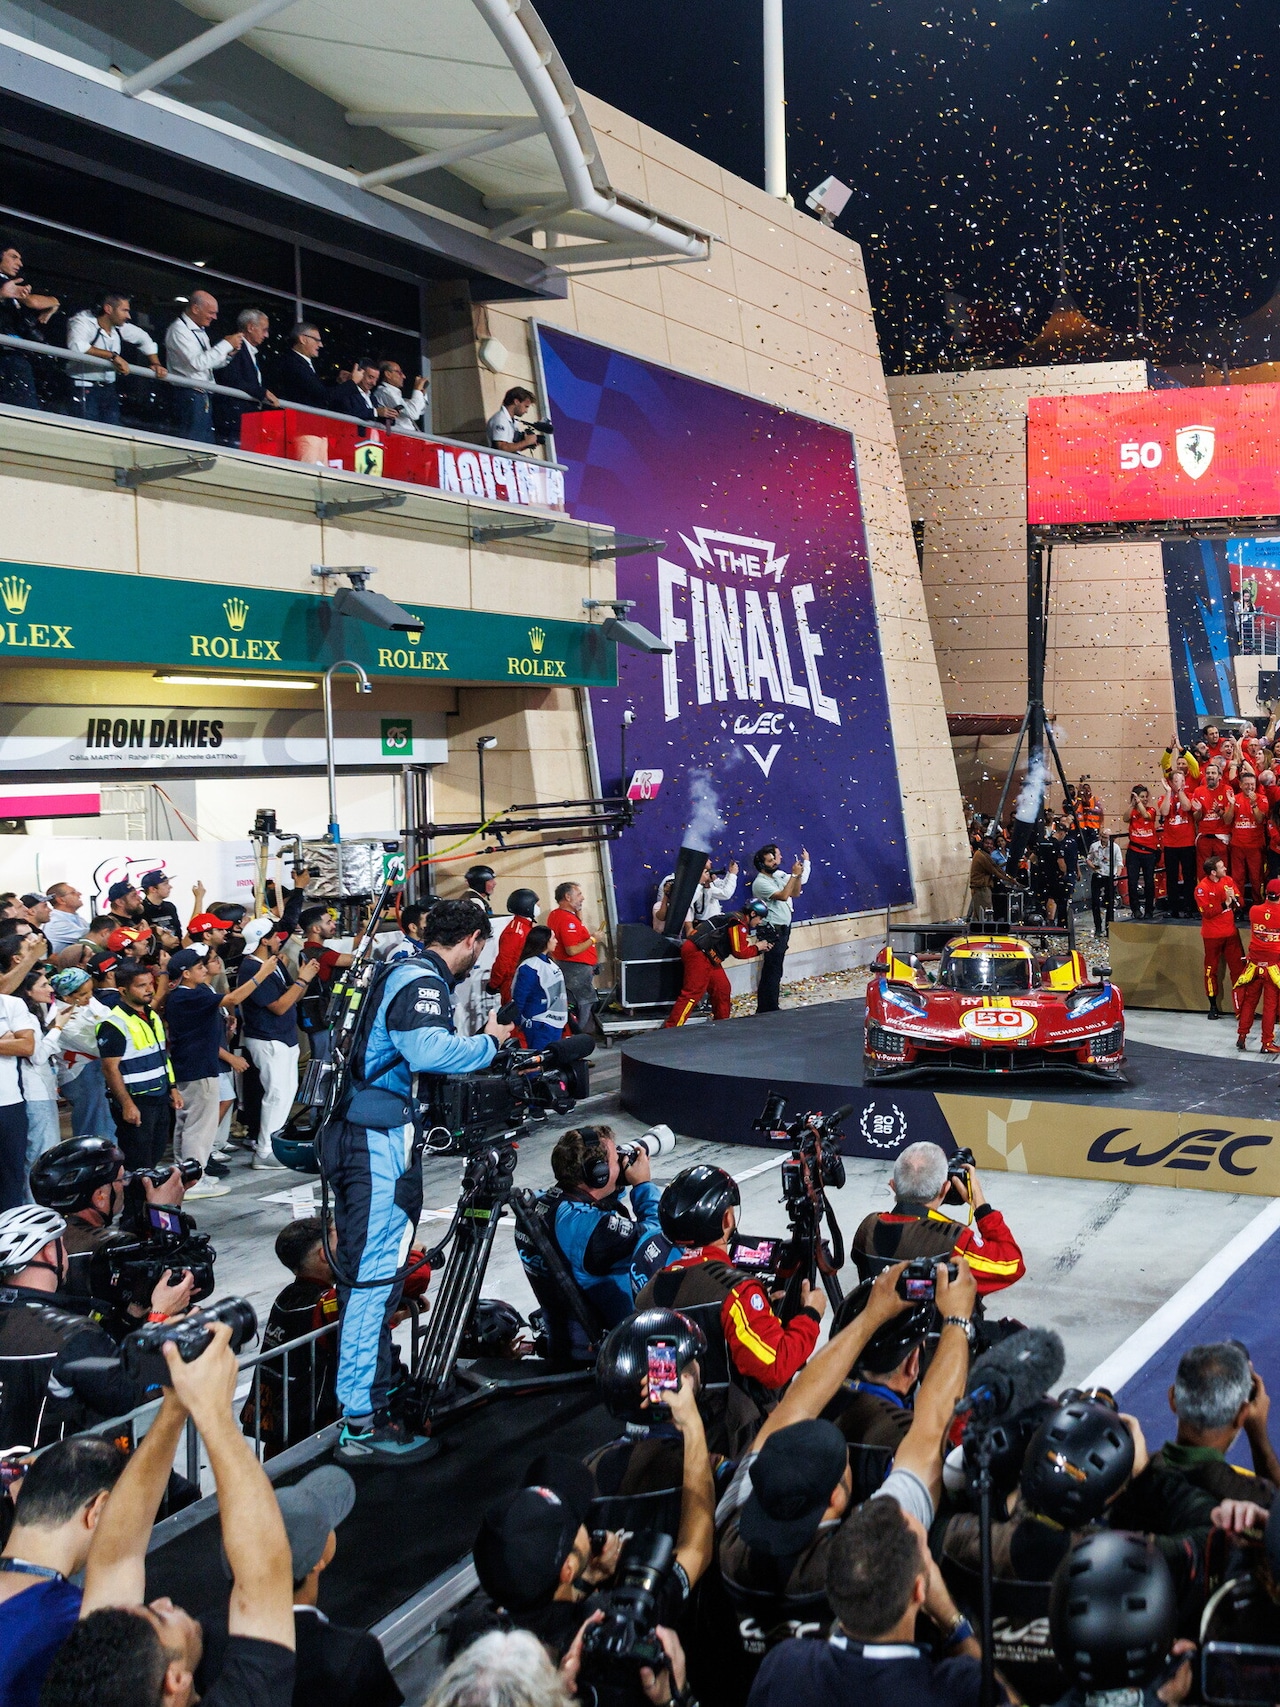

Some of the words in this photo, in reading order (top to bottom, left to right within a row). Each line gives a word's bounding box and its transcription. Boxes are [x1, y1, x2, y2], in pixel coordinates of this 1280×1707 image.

[1120, 441, 1162, 470] 50
[714, 548, 762, 578] THE
[0, 622, 75, 649] LEX
[657, 556, 842, 726] FINALE
[190, 635, 282, 661] ROLEX
[378, 648, 450, 671] ROLEX
[507, 657, 567, 679] ROLEX
[86, 718, 146, 748] IRON
[149, 719, 224, 748] DAMES
[733, 712, 785, 735] WEC
[977, 1012, 1021, 1025] 50
[1049, 1025, 1085, 1037] RICHARD
[1084, 1020, 1108, 1031] MILLE
[876, 1053, 905, 1062] V-Power
[873, 1114, 895, 1125] 20
[873, 1124, 894, 1135] 25
[1087, 1127, 1274, 1176] WEC
